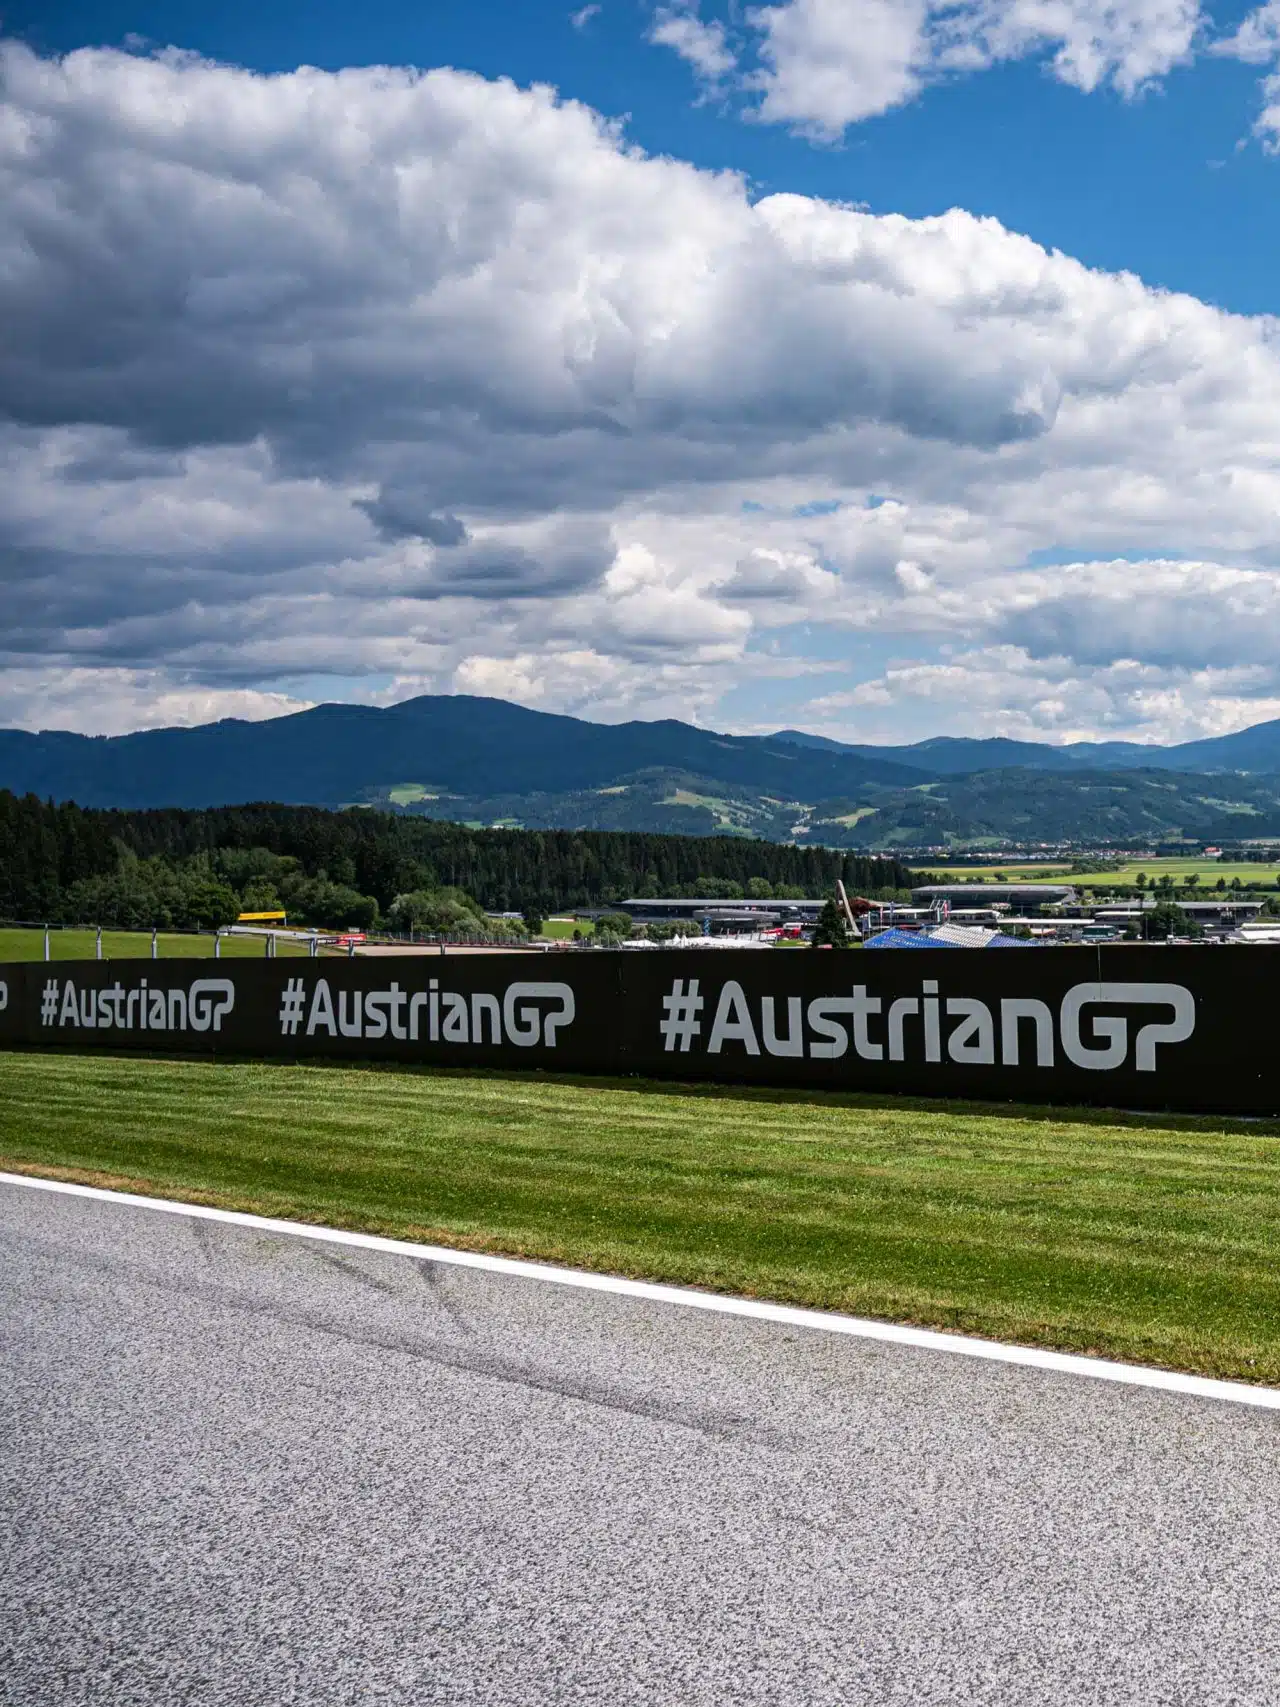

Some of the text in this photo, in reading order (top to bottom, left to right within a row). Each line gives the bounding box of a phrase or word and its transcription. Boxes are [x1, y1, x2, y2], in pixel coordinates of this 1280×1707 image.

[41, 978, 234, 1031] #AustrianGP
[279, 978, 575, 1047] #AustrianGP
[660, 979, 1196, 1071] #AustrianGP
